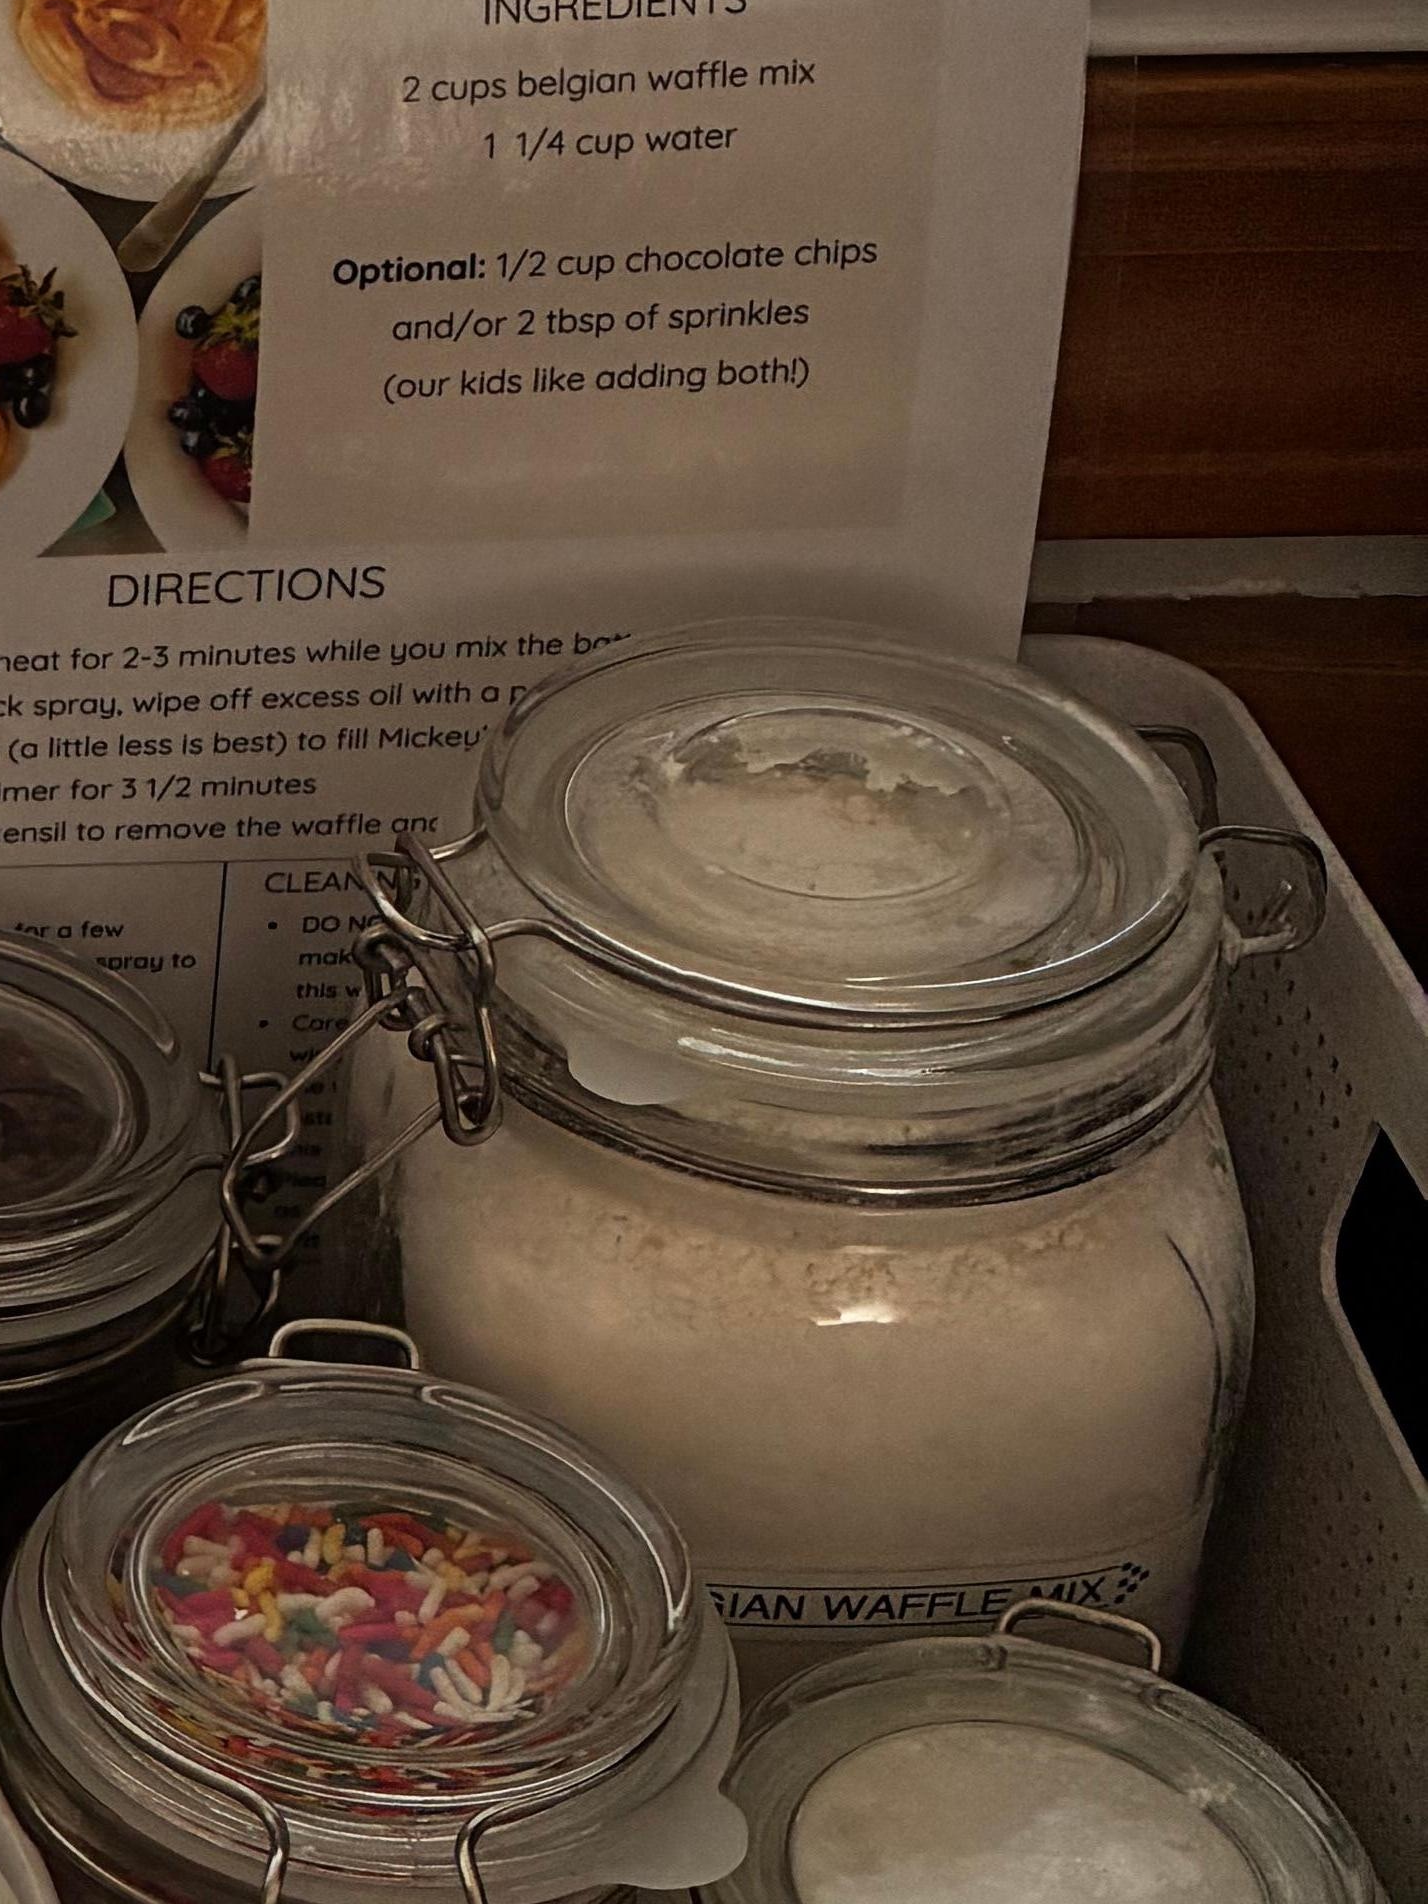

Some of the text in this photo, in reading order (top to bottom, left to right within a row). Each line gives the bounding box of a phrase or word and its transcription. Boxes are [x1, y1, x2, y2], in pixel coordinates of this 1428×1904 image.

[402, 58, 816, 107] 2 cups belgian waffle mix
[483, 125, 739, 162] 1 1/4 cup water
[332, 237, 878, 292] Optional: 1/2 cup chocolate chips
[391, 298, 810, 343] and/or 2 tbsp of sprinkles
[383, 356, 810, 406] (our kids like adding both!)
[107, 565, 387, 608] DIRECTIONS
[69, 647, 115, 671] for
[122, 645, 169, 670] 2-3
[178, 644, 296, 668] minutes
[305, 637, 381, 664] while
[390, 641, 446, 667] you
[455, 634, 509, 659] mix
[517, 632, 564, 657] the
[32, 696, 124, 721] spray,
[132, 691, 201, 719] wipe
[208, 686, 254, 712] off
[261, 689, 361, 710] excess
[368, 682, 404, 707] oil
[412, 680, 472, 705] with
[480, 685, 500, 704] a
[8, 738, 39, 765] (a
[48, 734, 109, 759] little
[118, 733, 173, 757] less
[181, 733, 204, 757] is
[212, 730, 288, 758] best)
[296, 731, 327, 752] to
[336, 727, 369, 751] fill
[70, 778, 115, 801] for
[121, 777, 137, 800] 3
[145, 773, 192, 803] 1/2
[200, 775, 317, 798] minutes
[76, 822, 106, 842] to
[114, 821, 227, 842] remove
[235, 815, 282, 838] the
[291, 812, 382, 837] waffle
[56, 925, 73, 940] a
[80, 919, 125, 939] few
[303, 916, 340, 933] DO
[171, 952, 197, 969] to
[297, 983, 336, 999] this
[823, 1588, 1012, 1621] WAFFLE
